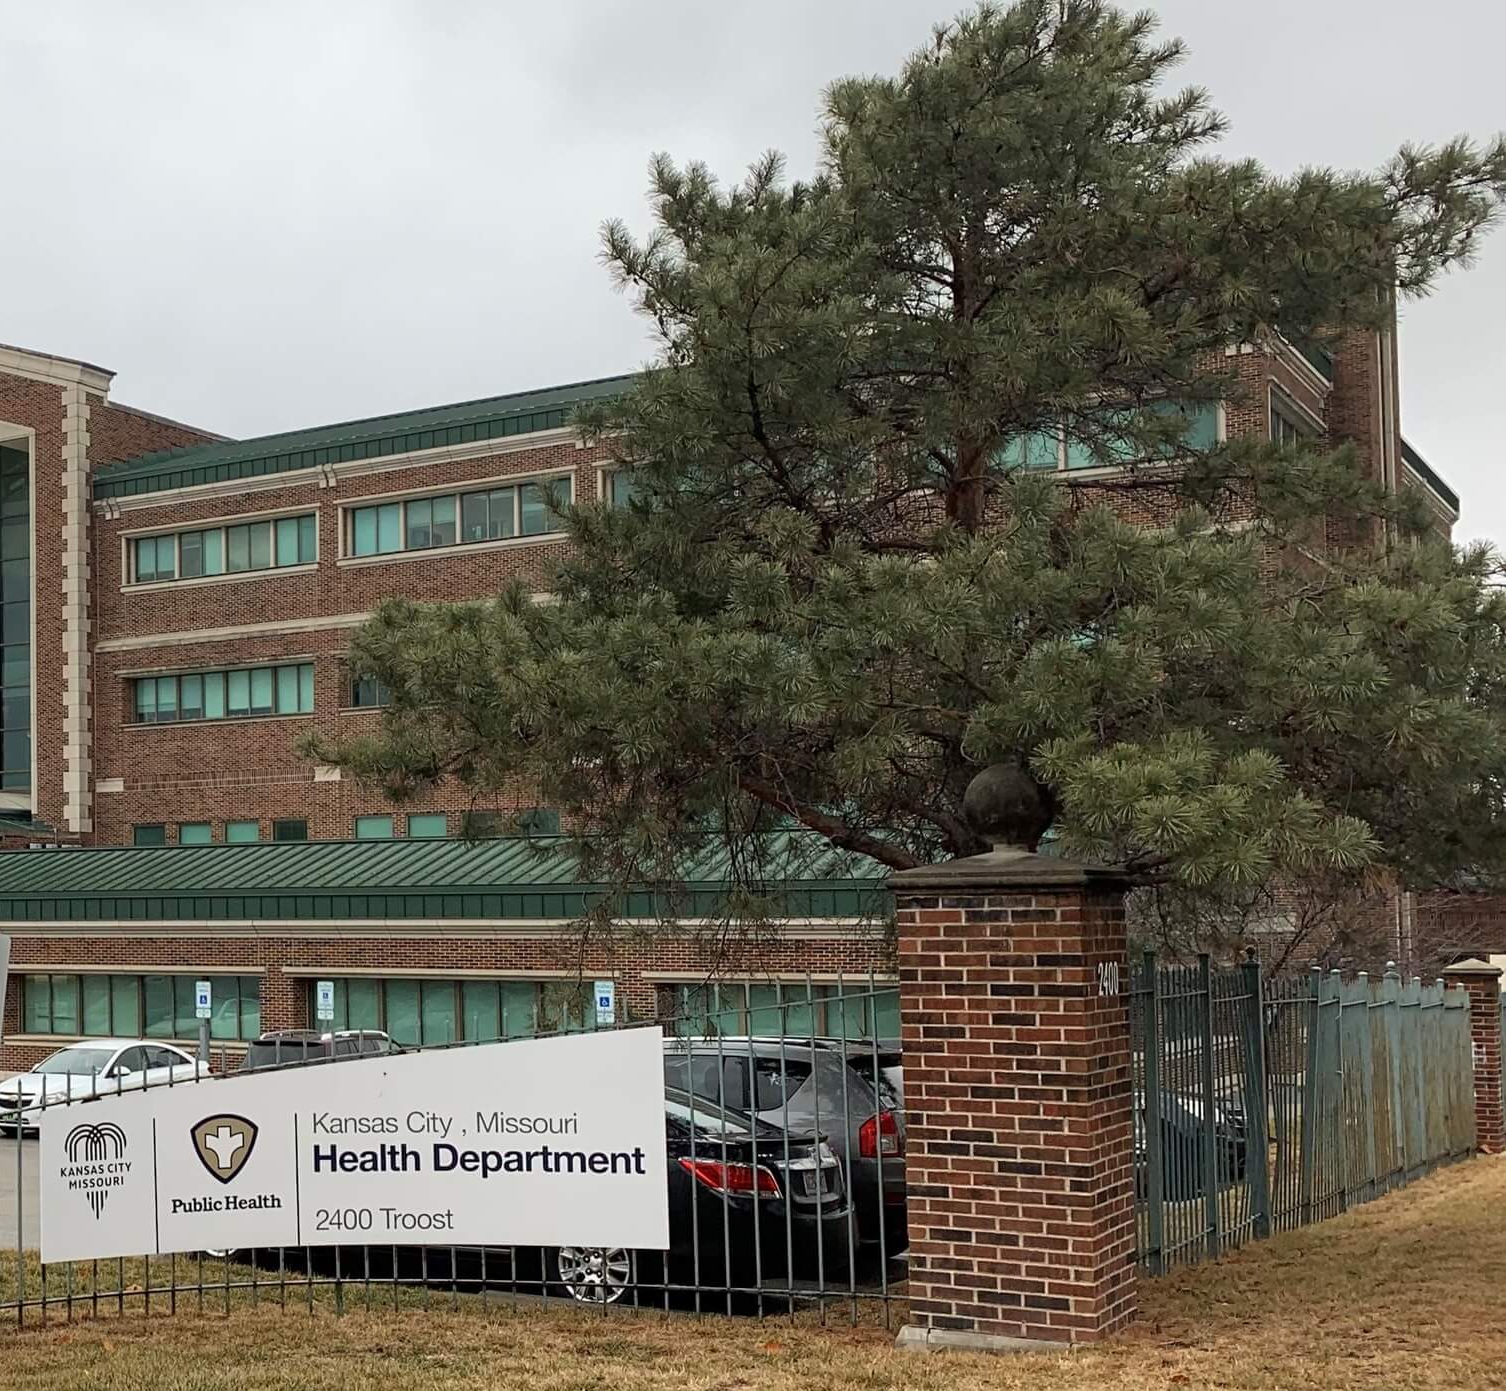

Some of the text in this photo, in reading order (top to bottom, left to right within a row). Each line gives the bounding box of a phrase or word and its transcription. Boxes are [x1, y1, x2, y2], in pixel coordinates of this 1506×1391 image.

[1098, 961, 1119, 996] 2400
[313, 1112, 399, 1134] Kansas
[406, 1111, 453, 1138] City
[476, 1112, 578, 1134] Missouri
[60, 1162, 132, 1177] KANSAS CITY
[313, 1144, 646, 1179] Health Department
[69, 1176, 124, 1190] MISSOURI
[171, 1195, 282, 1214] Public Health
[315, 1208, 454, 1231] 2400 Troost
